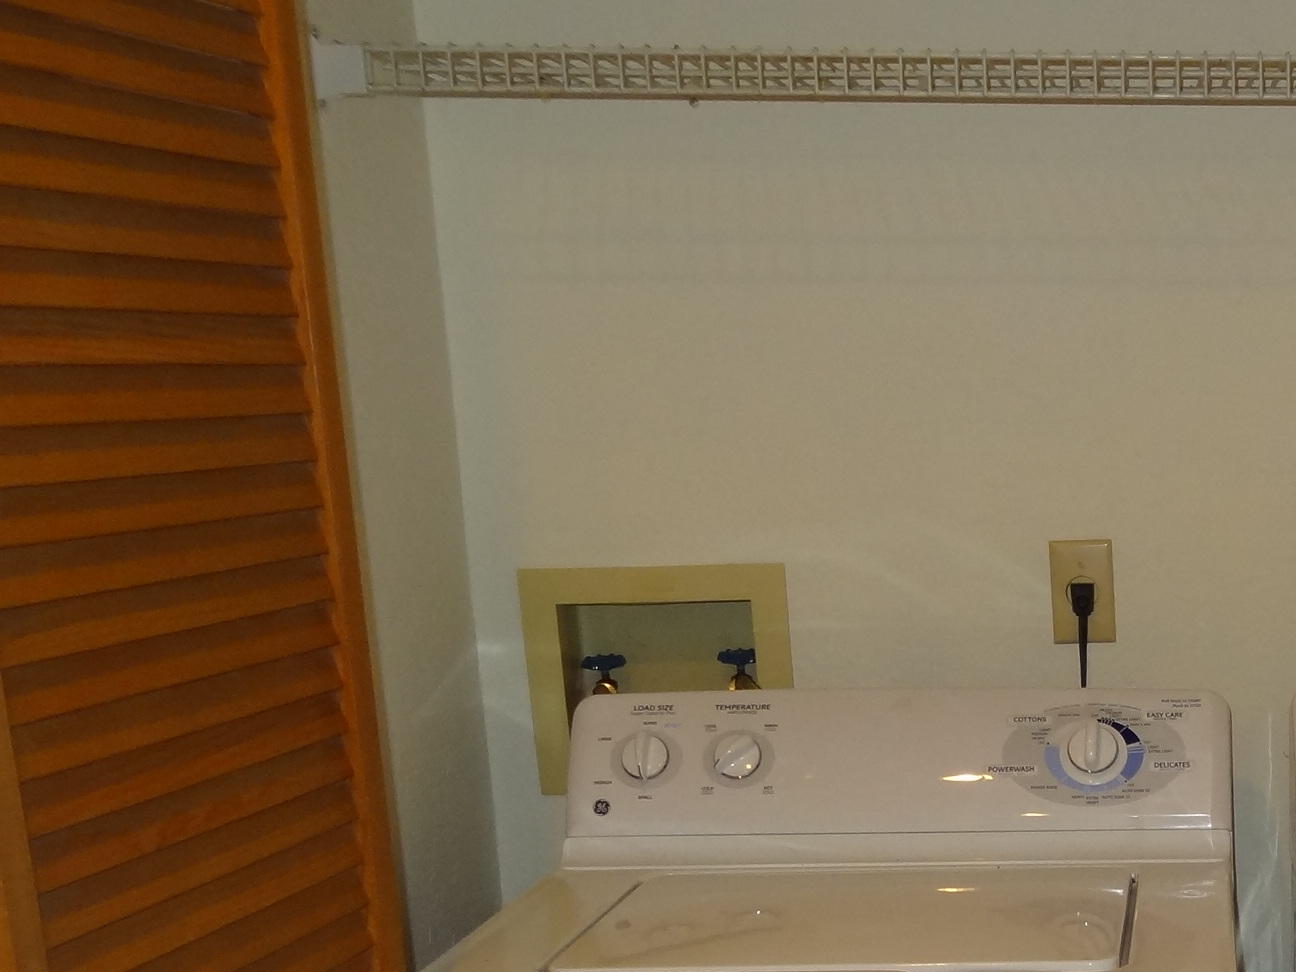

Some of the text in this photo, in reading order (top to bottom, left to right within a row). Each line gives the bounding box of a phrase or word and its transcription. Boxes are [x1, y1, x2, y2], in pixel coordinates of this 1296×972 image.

[715, 703, 772, 711] TEMPERATURE
[987, 765, 1035, 773] POWERWASH
[1153, 761, 1191, 769] DELICATES
